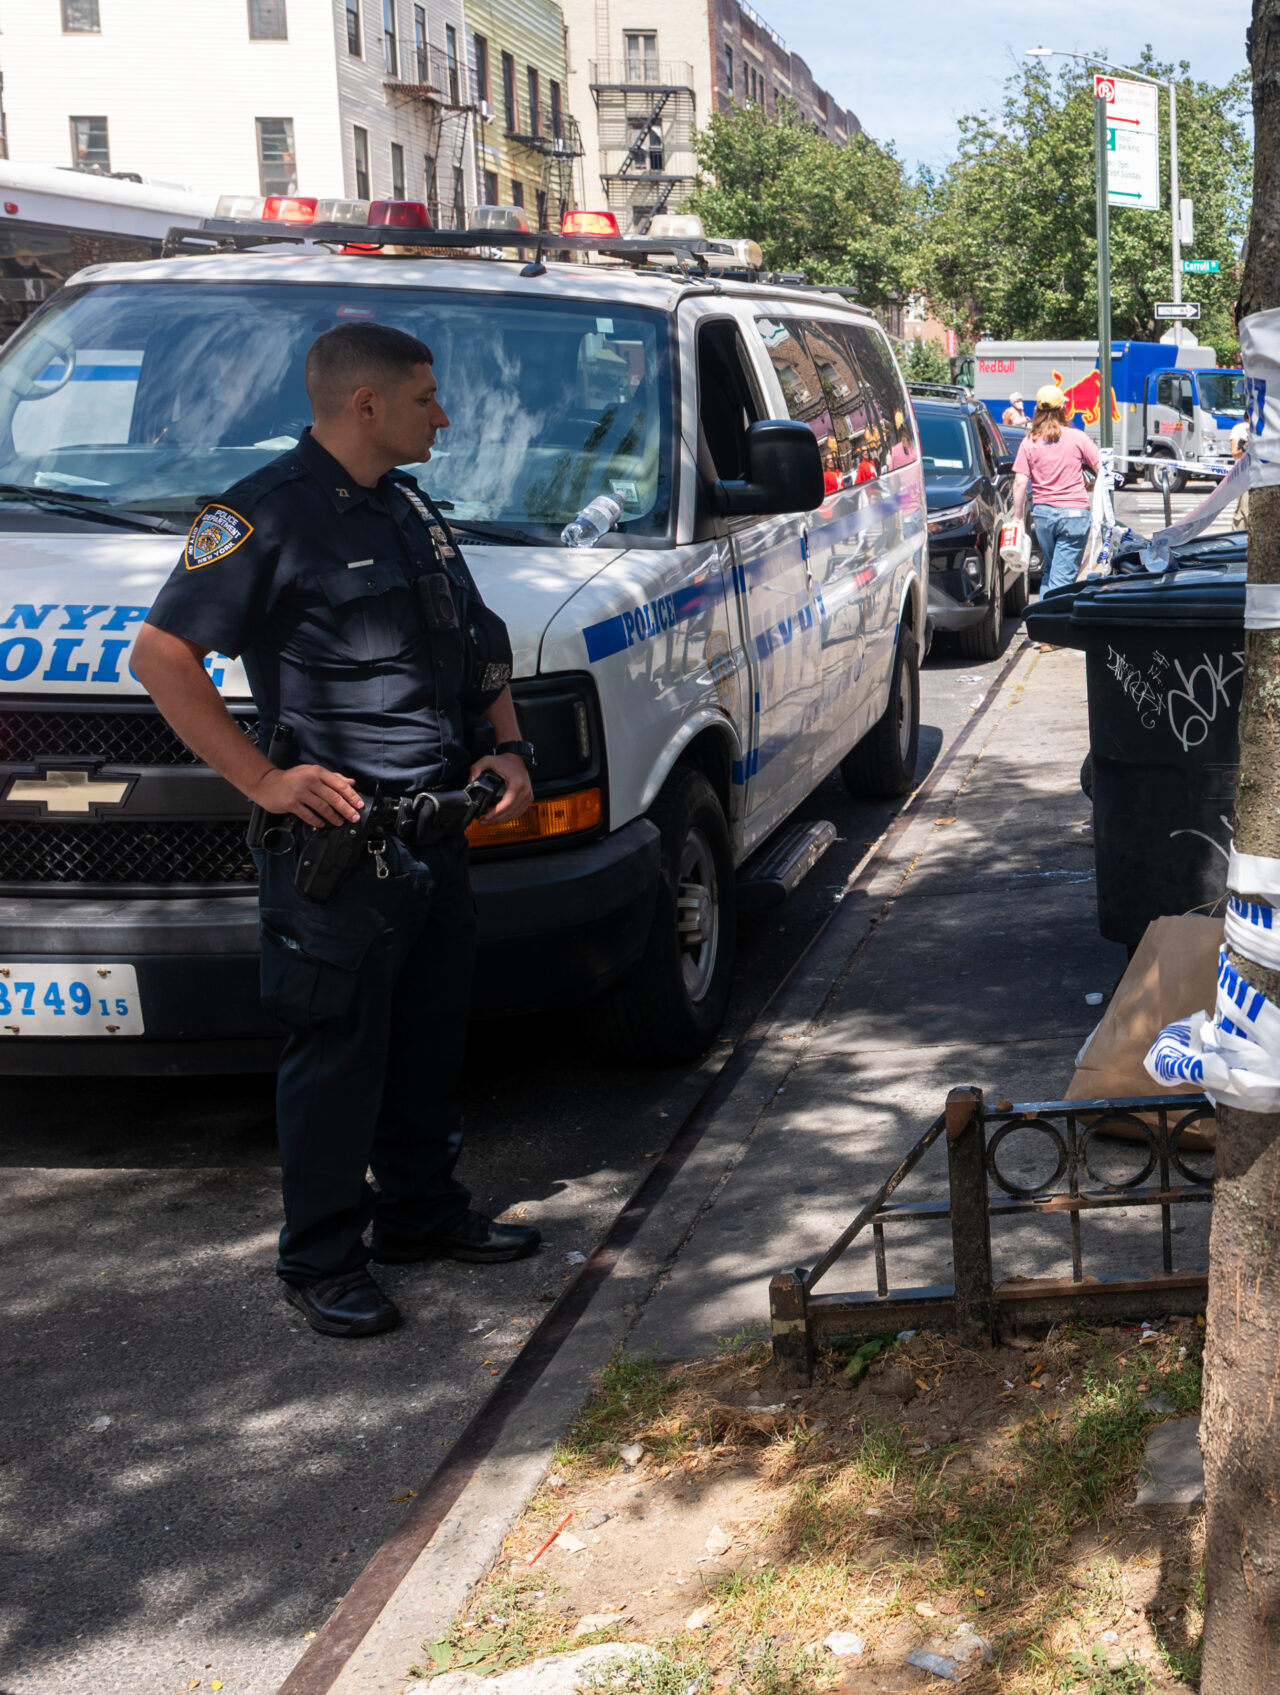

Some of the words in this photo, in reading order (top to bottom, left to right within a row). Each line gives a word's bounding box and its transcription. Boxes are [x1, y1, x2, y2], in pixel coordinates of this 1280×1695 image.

[1184, 261, 1209, 271] Carroll
[979, 360, 996, 373] Red
[997, 360, 1015, 373] Bull
[202, 513, 242, 539] DEPARTMENT
[215, 509, 239, 527] POLICE
[197, 554, 213, 565] NEW
[213, 541, 236, 557] YORK
[0, 604, 151, 631] NYP
[622, 594, 677, 648] POLICE
[99, 998, 128, 1016] 15
